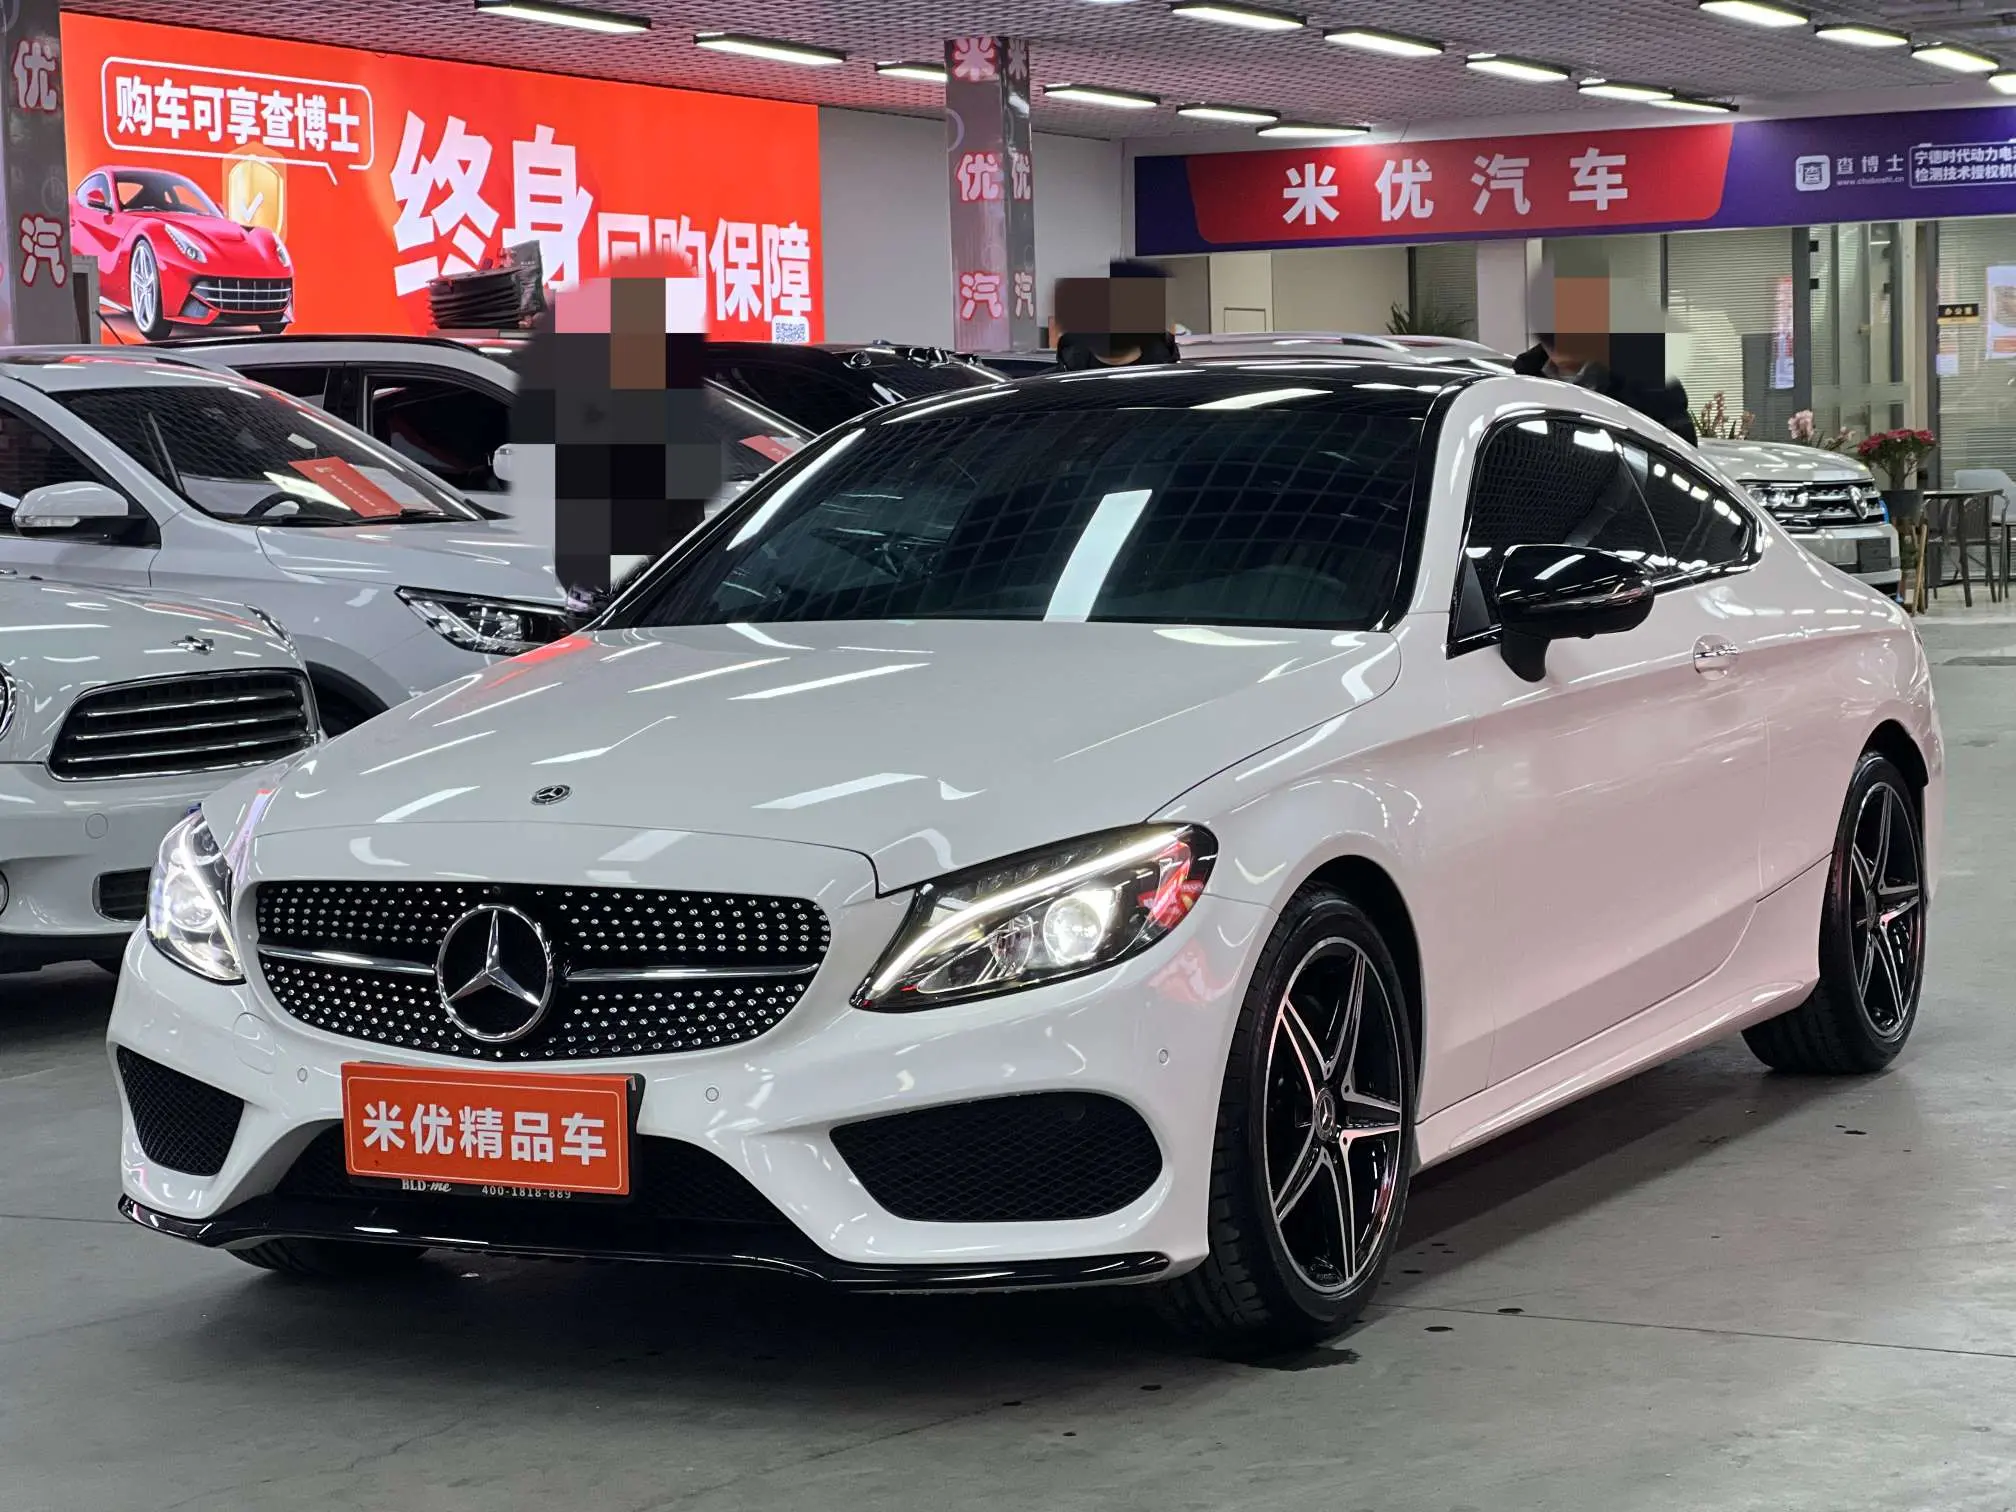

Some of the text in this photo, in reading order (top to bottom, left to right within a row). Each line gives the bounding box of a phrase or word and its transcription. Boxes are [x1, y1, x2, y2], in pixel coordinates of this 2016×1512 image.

[115, 75, 360, 153] 购车可享查博士
[1283, 147, 1628, 225] 米优汽车
[1836, 154, 1904, 175] 查博士
[362, 1100, 607, 1166] 米优精品车
